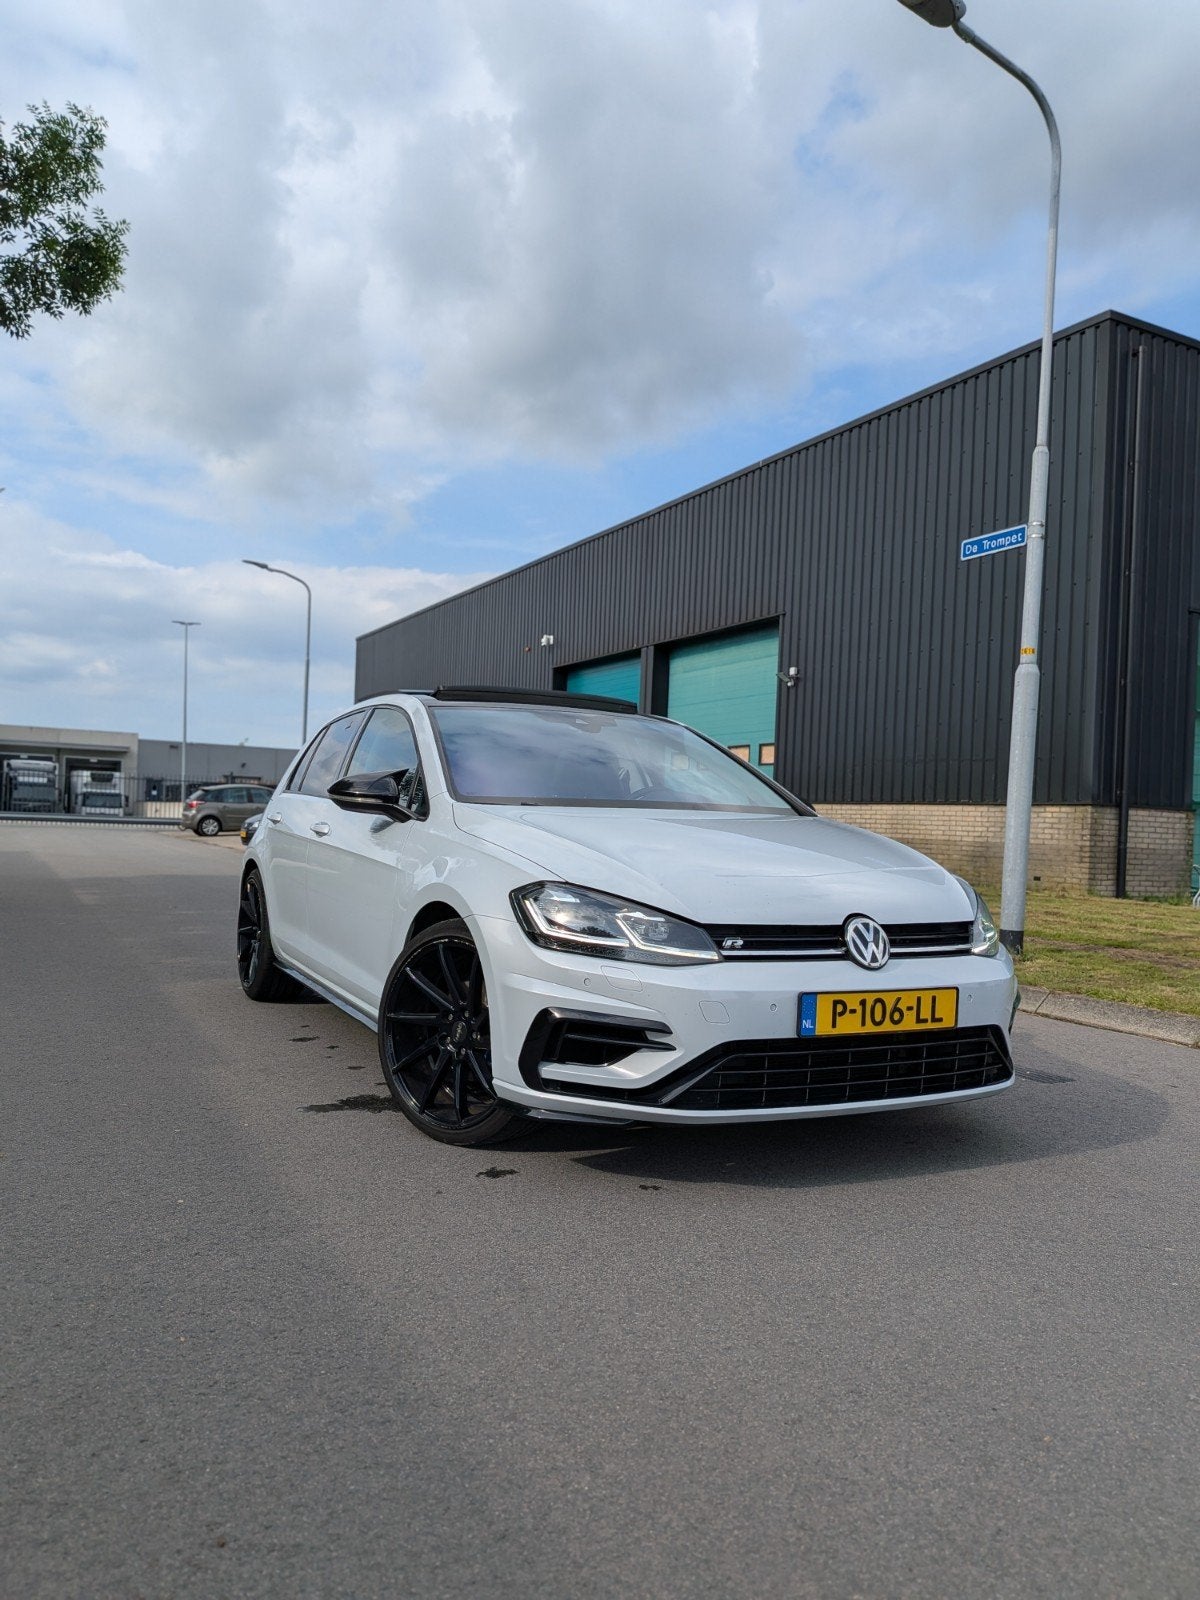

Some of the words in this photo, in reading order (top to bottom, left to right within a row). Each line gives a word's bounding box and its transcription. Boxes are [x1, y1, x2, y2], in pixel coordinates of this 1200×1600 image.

[965, 544, 978, 555] De
[722, 937, 744, 949] R
[831, 995, 943, 1028] P-106-LL
[802, 1019, 814, 1029] NL
